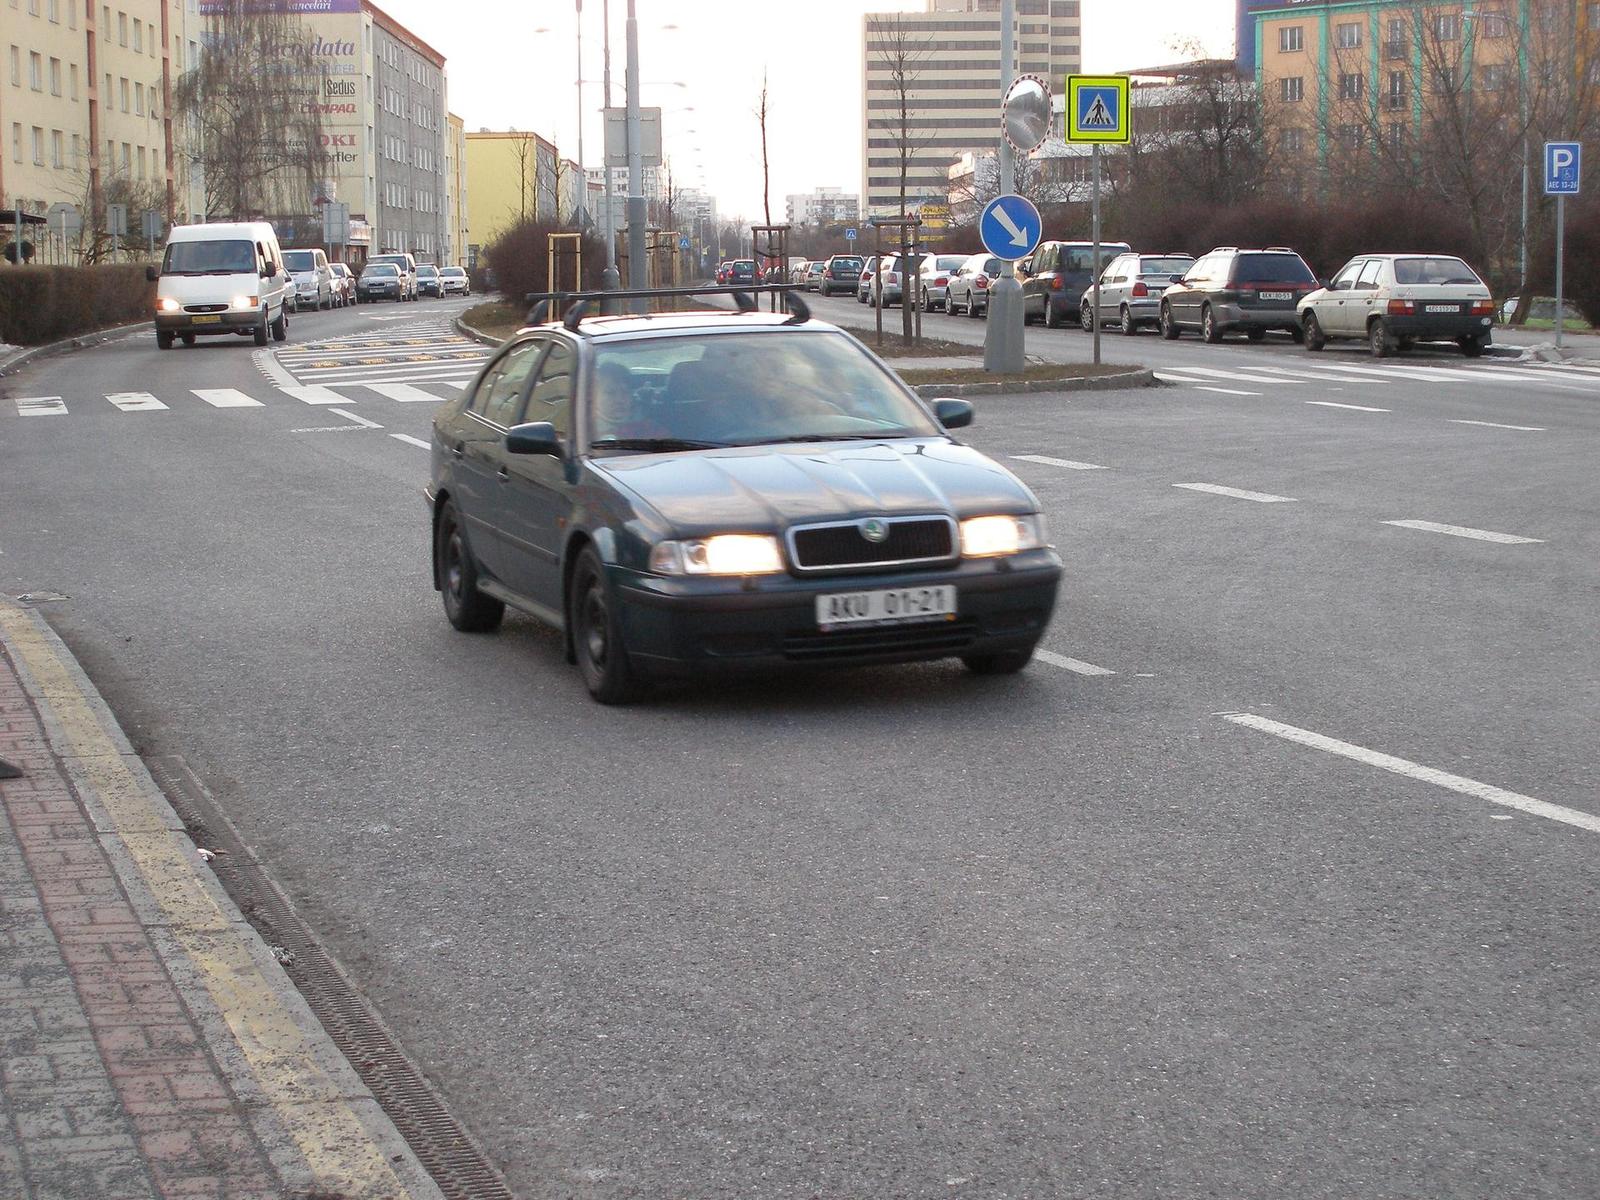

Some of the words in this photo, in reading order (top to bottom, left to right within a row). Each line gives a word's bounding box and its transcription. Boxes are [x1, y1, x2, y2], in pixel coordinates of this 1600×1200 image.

[311, 35, 355, 56] data
[327, 79, 356, 95] Sedus
[1553, 149, 1573, 177] P
[884, 588, 945, 615] 01-21
